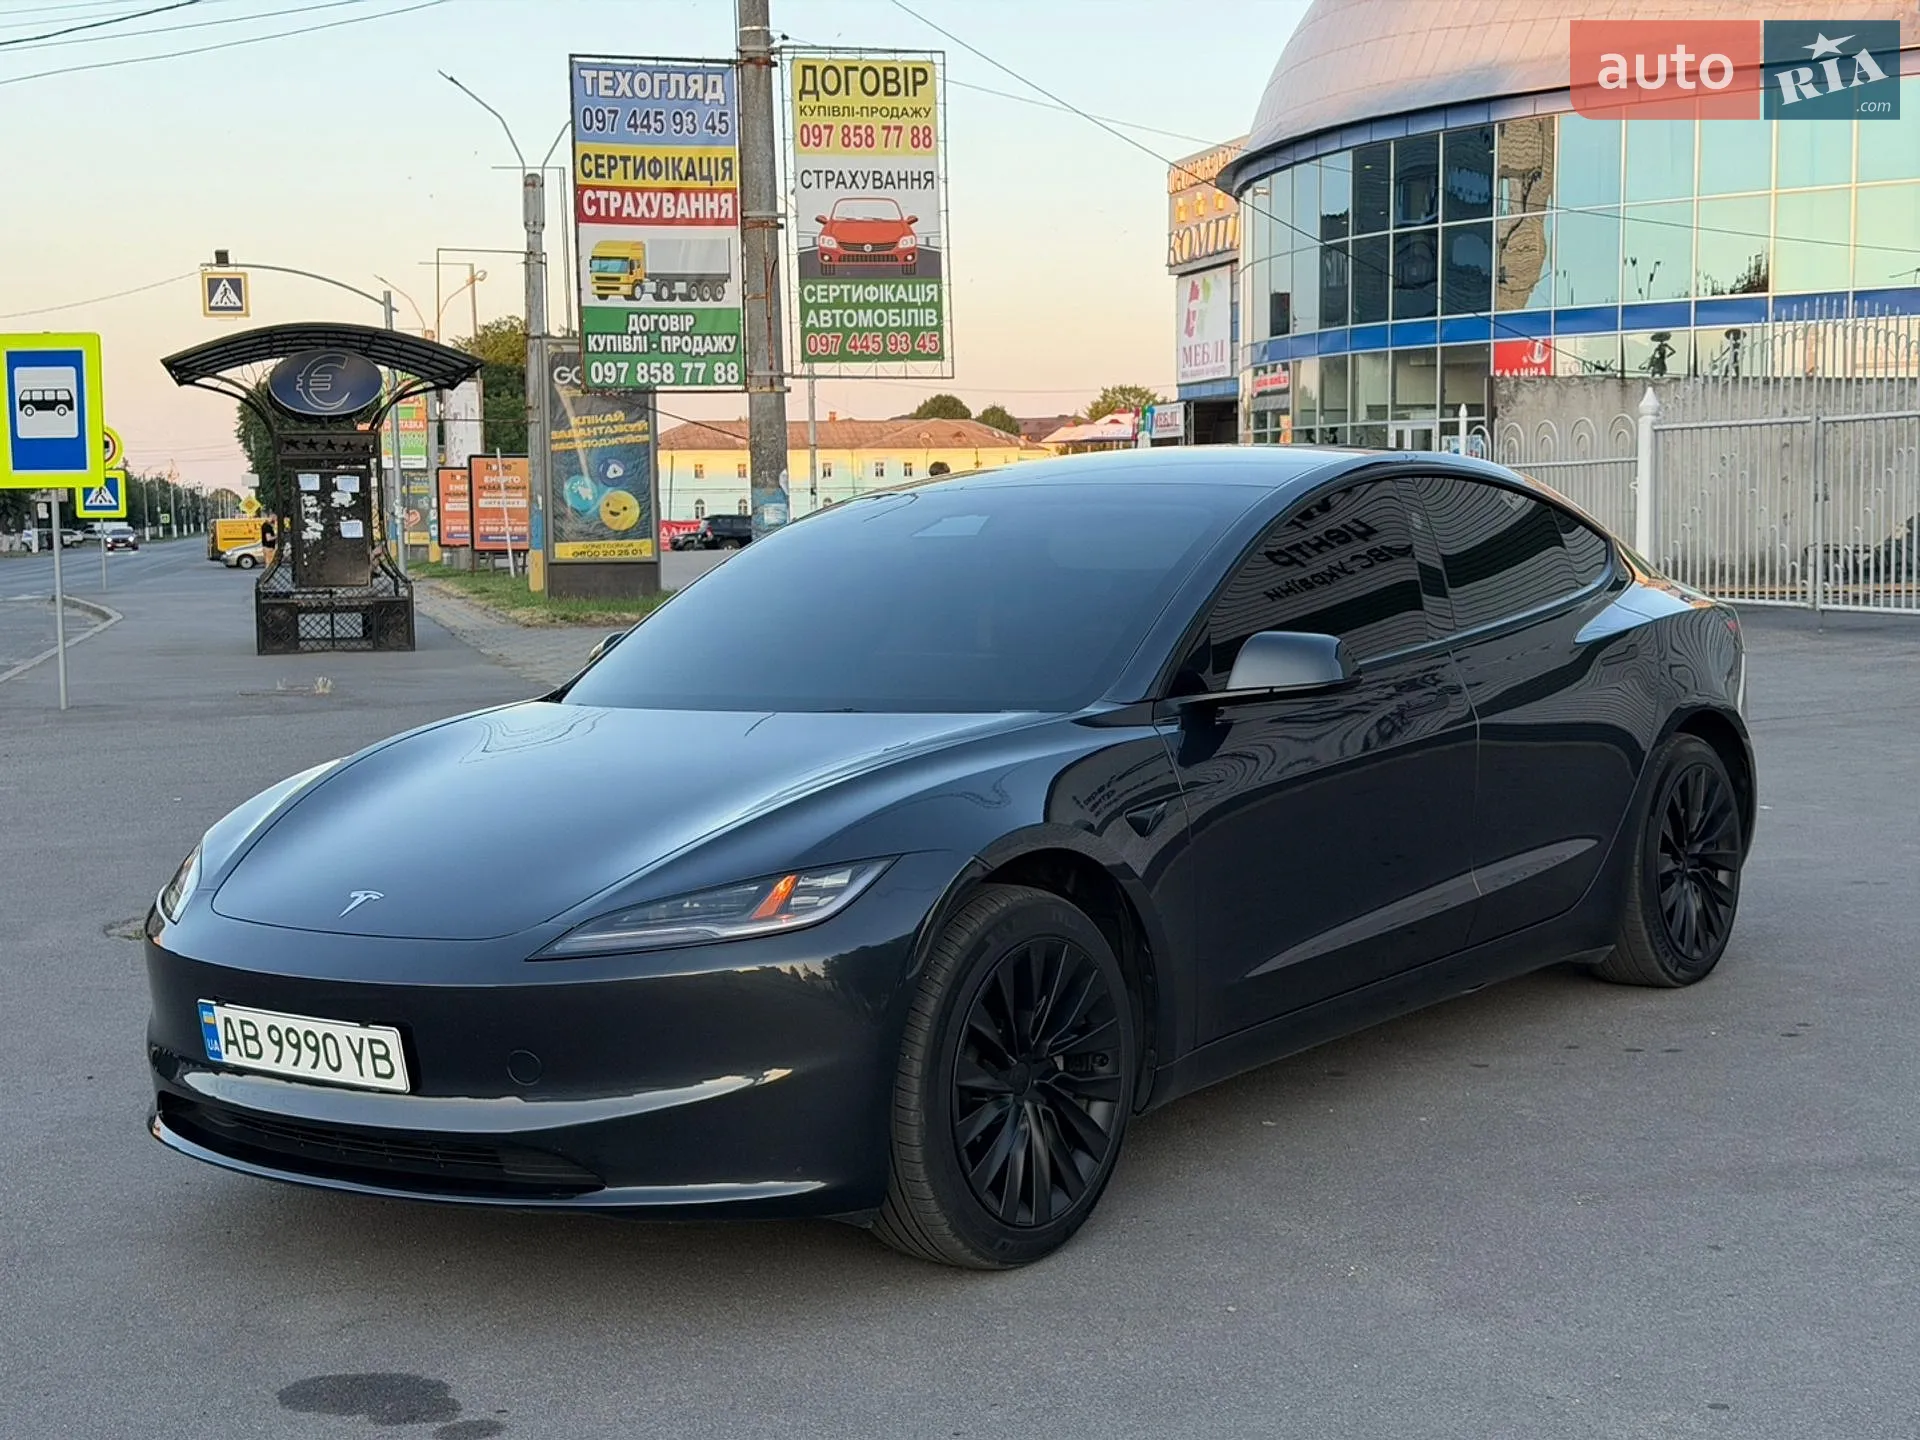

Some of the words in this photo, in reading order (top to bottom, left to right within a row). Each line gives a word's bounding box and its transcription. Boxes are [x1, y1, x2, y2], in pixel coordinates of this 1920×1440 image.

[580, 69, 725, 105] ТЕХОГЛЯД
[799, 65, 928, 101] ДОГОВІР
[582, 107, 619, 132] 097
[627, 109, 664, 134] 445
[672, 111, 697, 135] 93
[704, 111, 730, 135] 45
[799, 105, 931, 120] КУПІВЛІ-ПРОДАЖУ
[800, 124, 834, 147] 097
[841, 125, 875, 148] 858
[881, 125, 903, 148] 77
[910, 125, 932, 149] 88
[580, 153, 733, 186] СЕРТИФІКАЦІЯ
[800, 169, 934, 190] СТРАХУВАННЯ
[582, 189, 733, 219] СТРАХУВАННЯ
[803, 283, 938, 306] СЕРТИФІКАЦІЯ
[628, 314, 694, 333] ДОГОВІР
[805, 308, 938, 328] АВТОМОБІЛІВ
[587, 335, 647, 352] КУПІВЛІ
[661, 335, 737, 355] ПРОДАЖУ
[808, 334, 842, 354] 097
[848, 333, 881, 354] 445
[888, 332, 911, 353] 93
[916, 332, 939, 353] 45
[590, 362, 629, 384] 097
[636, 362, 674, 384] 858
[681, 362, 706, 383] 77
[713, 362, 739, 384] 88
[207, 1041, 220, 1051] UA
[223, 1016, 263, 1059] AB
[267, 1024, 342, 1072] 9990
[345, 1035, 395, 1079] YB
